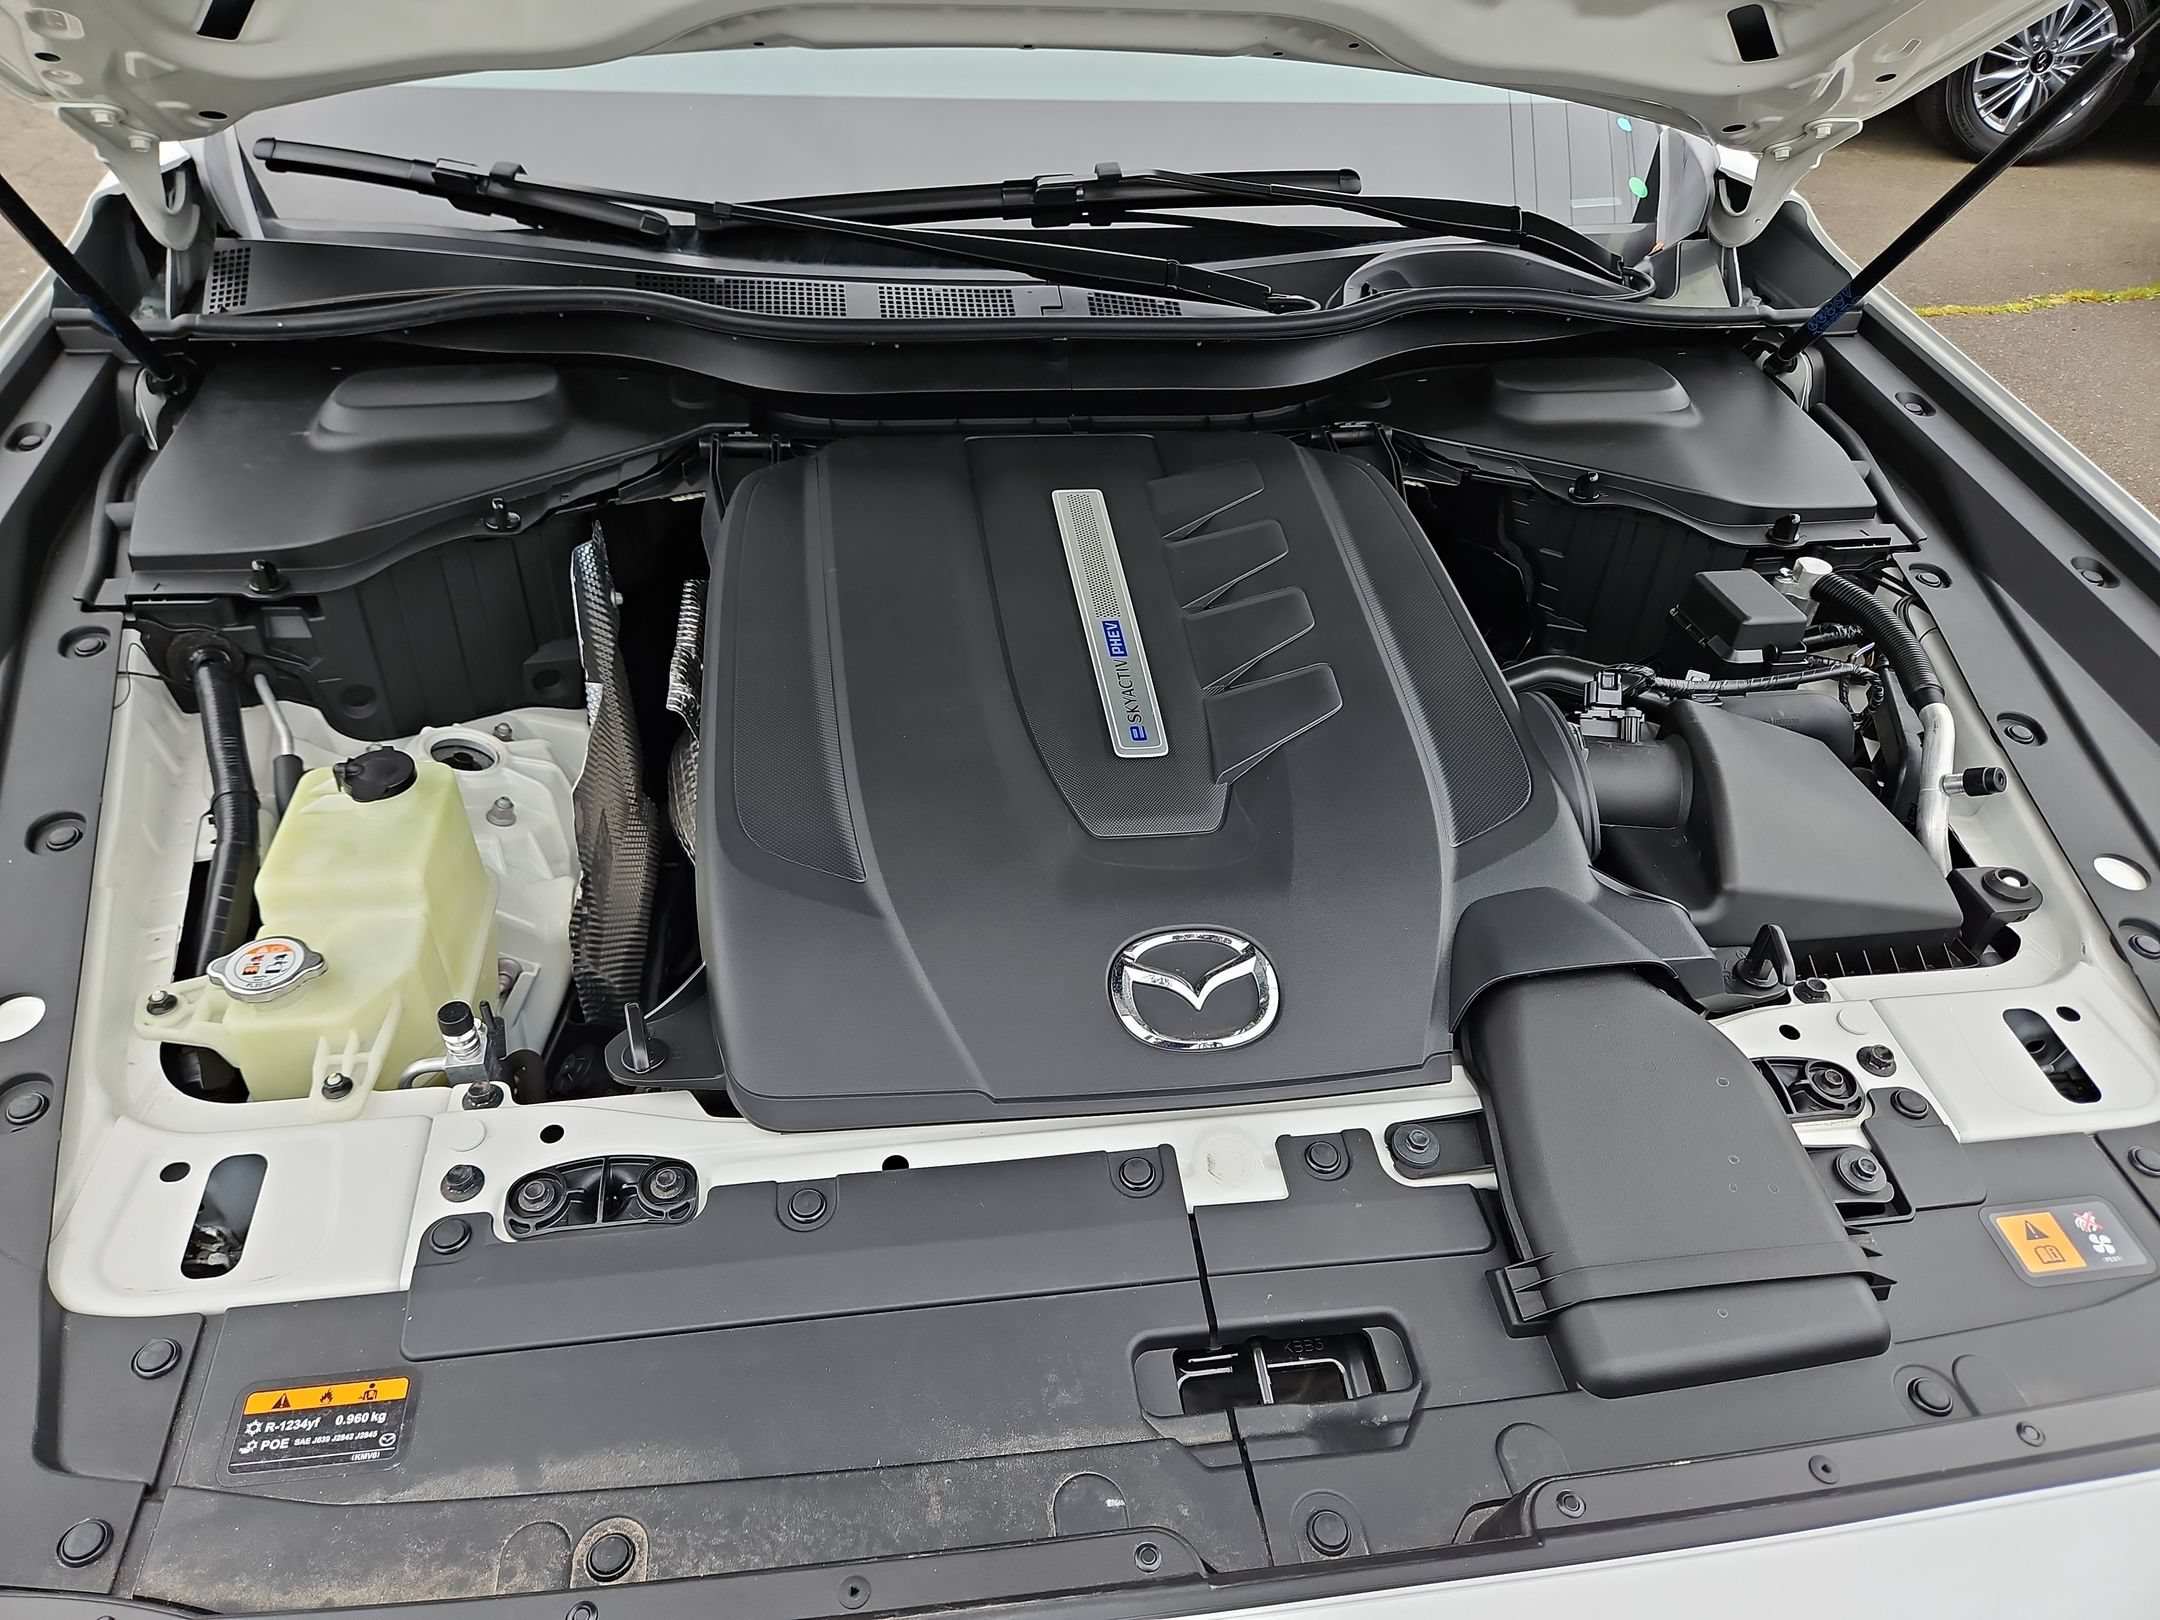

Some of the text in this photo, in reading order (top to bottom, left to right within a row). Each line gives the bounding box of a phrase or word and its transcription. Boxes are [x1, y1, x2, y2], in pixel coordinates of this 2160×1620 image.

[1103, 621, 1126, 656] PHEV
[1113, 659, 1142, 723] SKYACTIV
[264, 1411, 387, 1432] R-1234yf 0.960 kg
[260, 1430, 378, 1451] POE SAE J639 J2842 J2845
